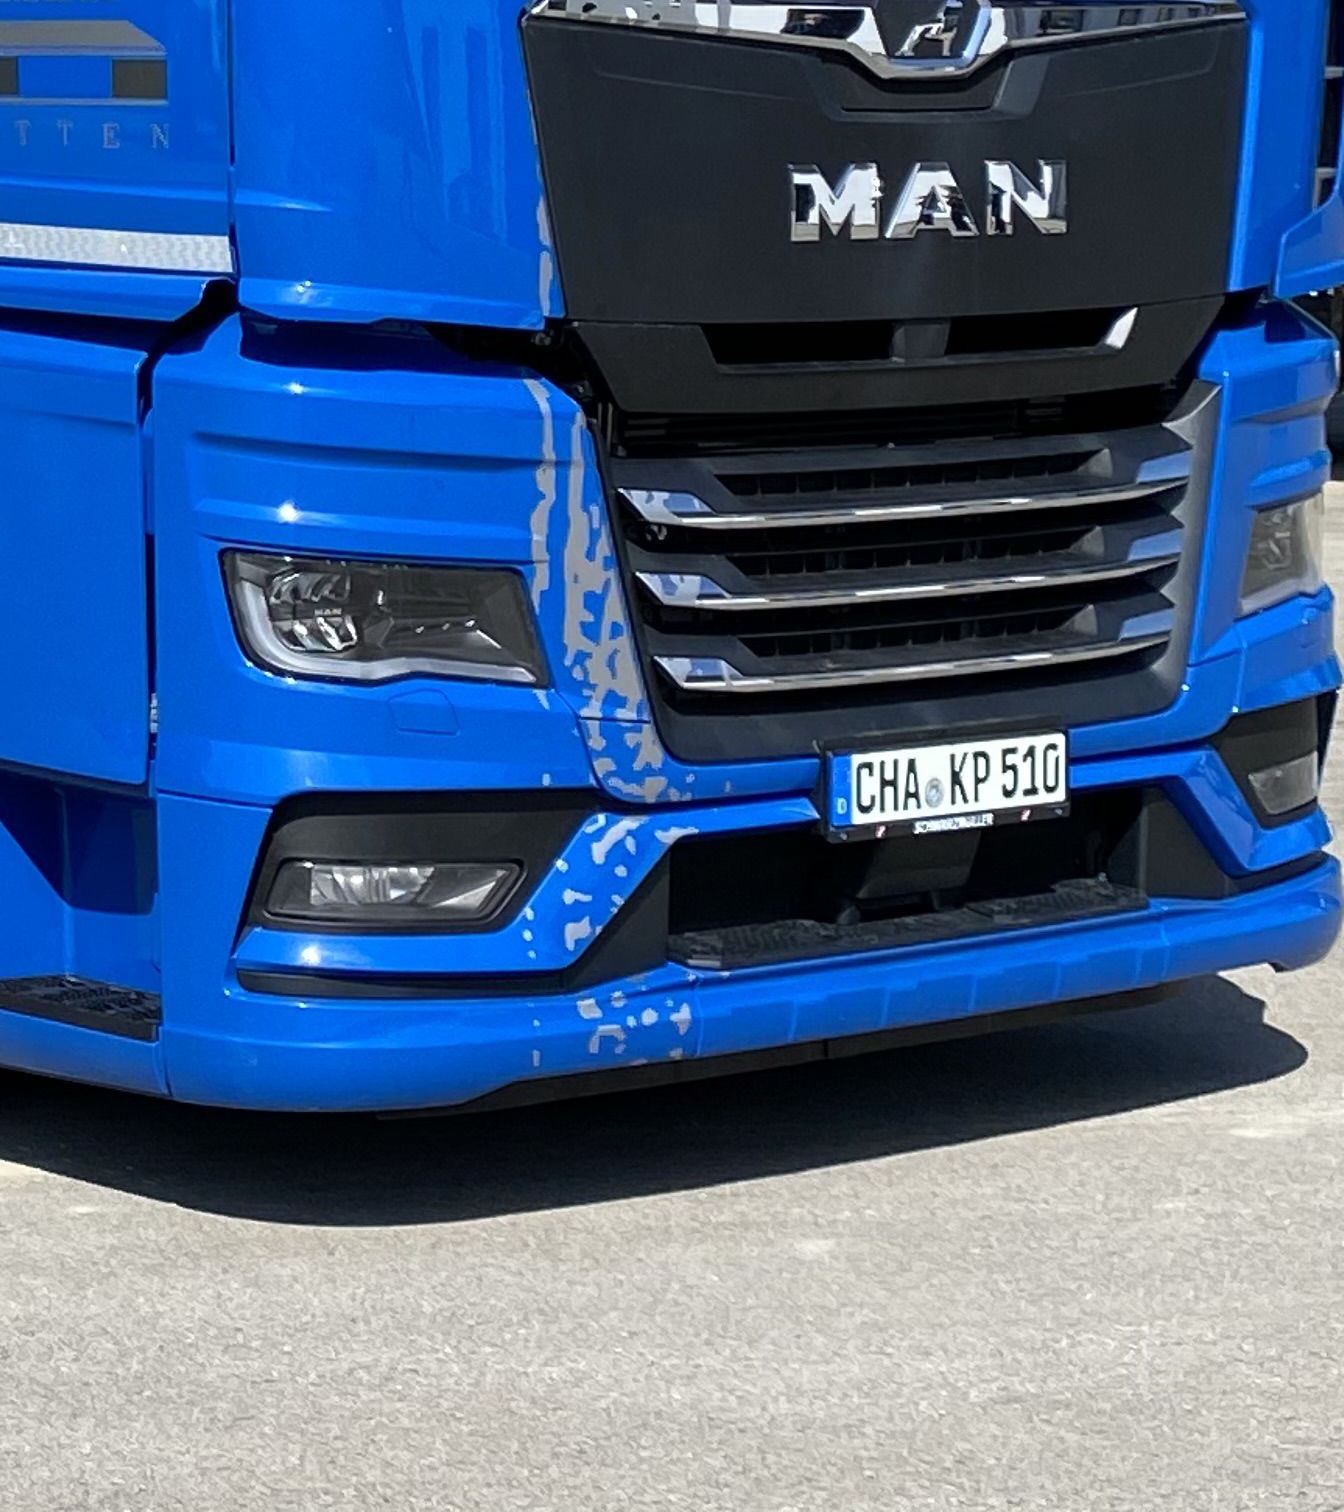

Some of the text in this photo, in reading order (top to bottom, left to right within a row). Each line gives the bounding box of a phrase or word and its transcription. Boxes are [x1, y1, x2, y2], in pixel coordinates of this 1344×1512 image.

[787, 159, 1067, 241] MAN
[856, 742, 1060, 814] CHA KP 510
